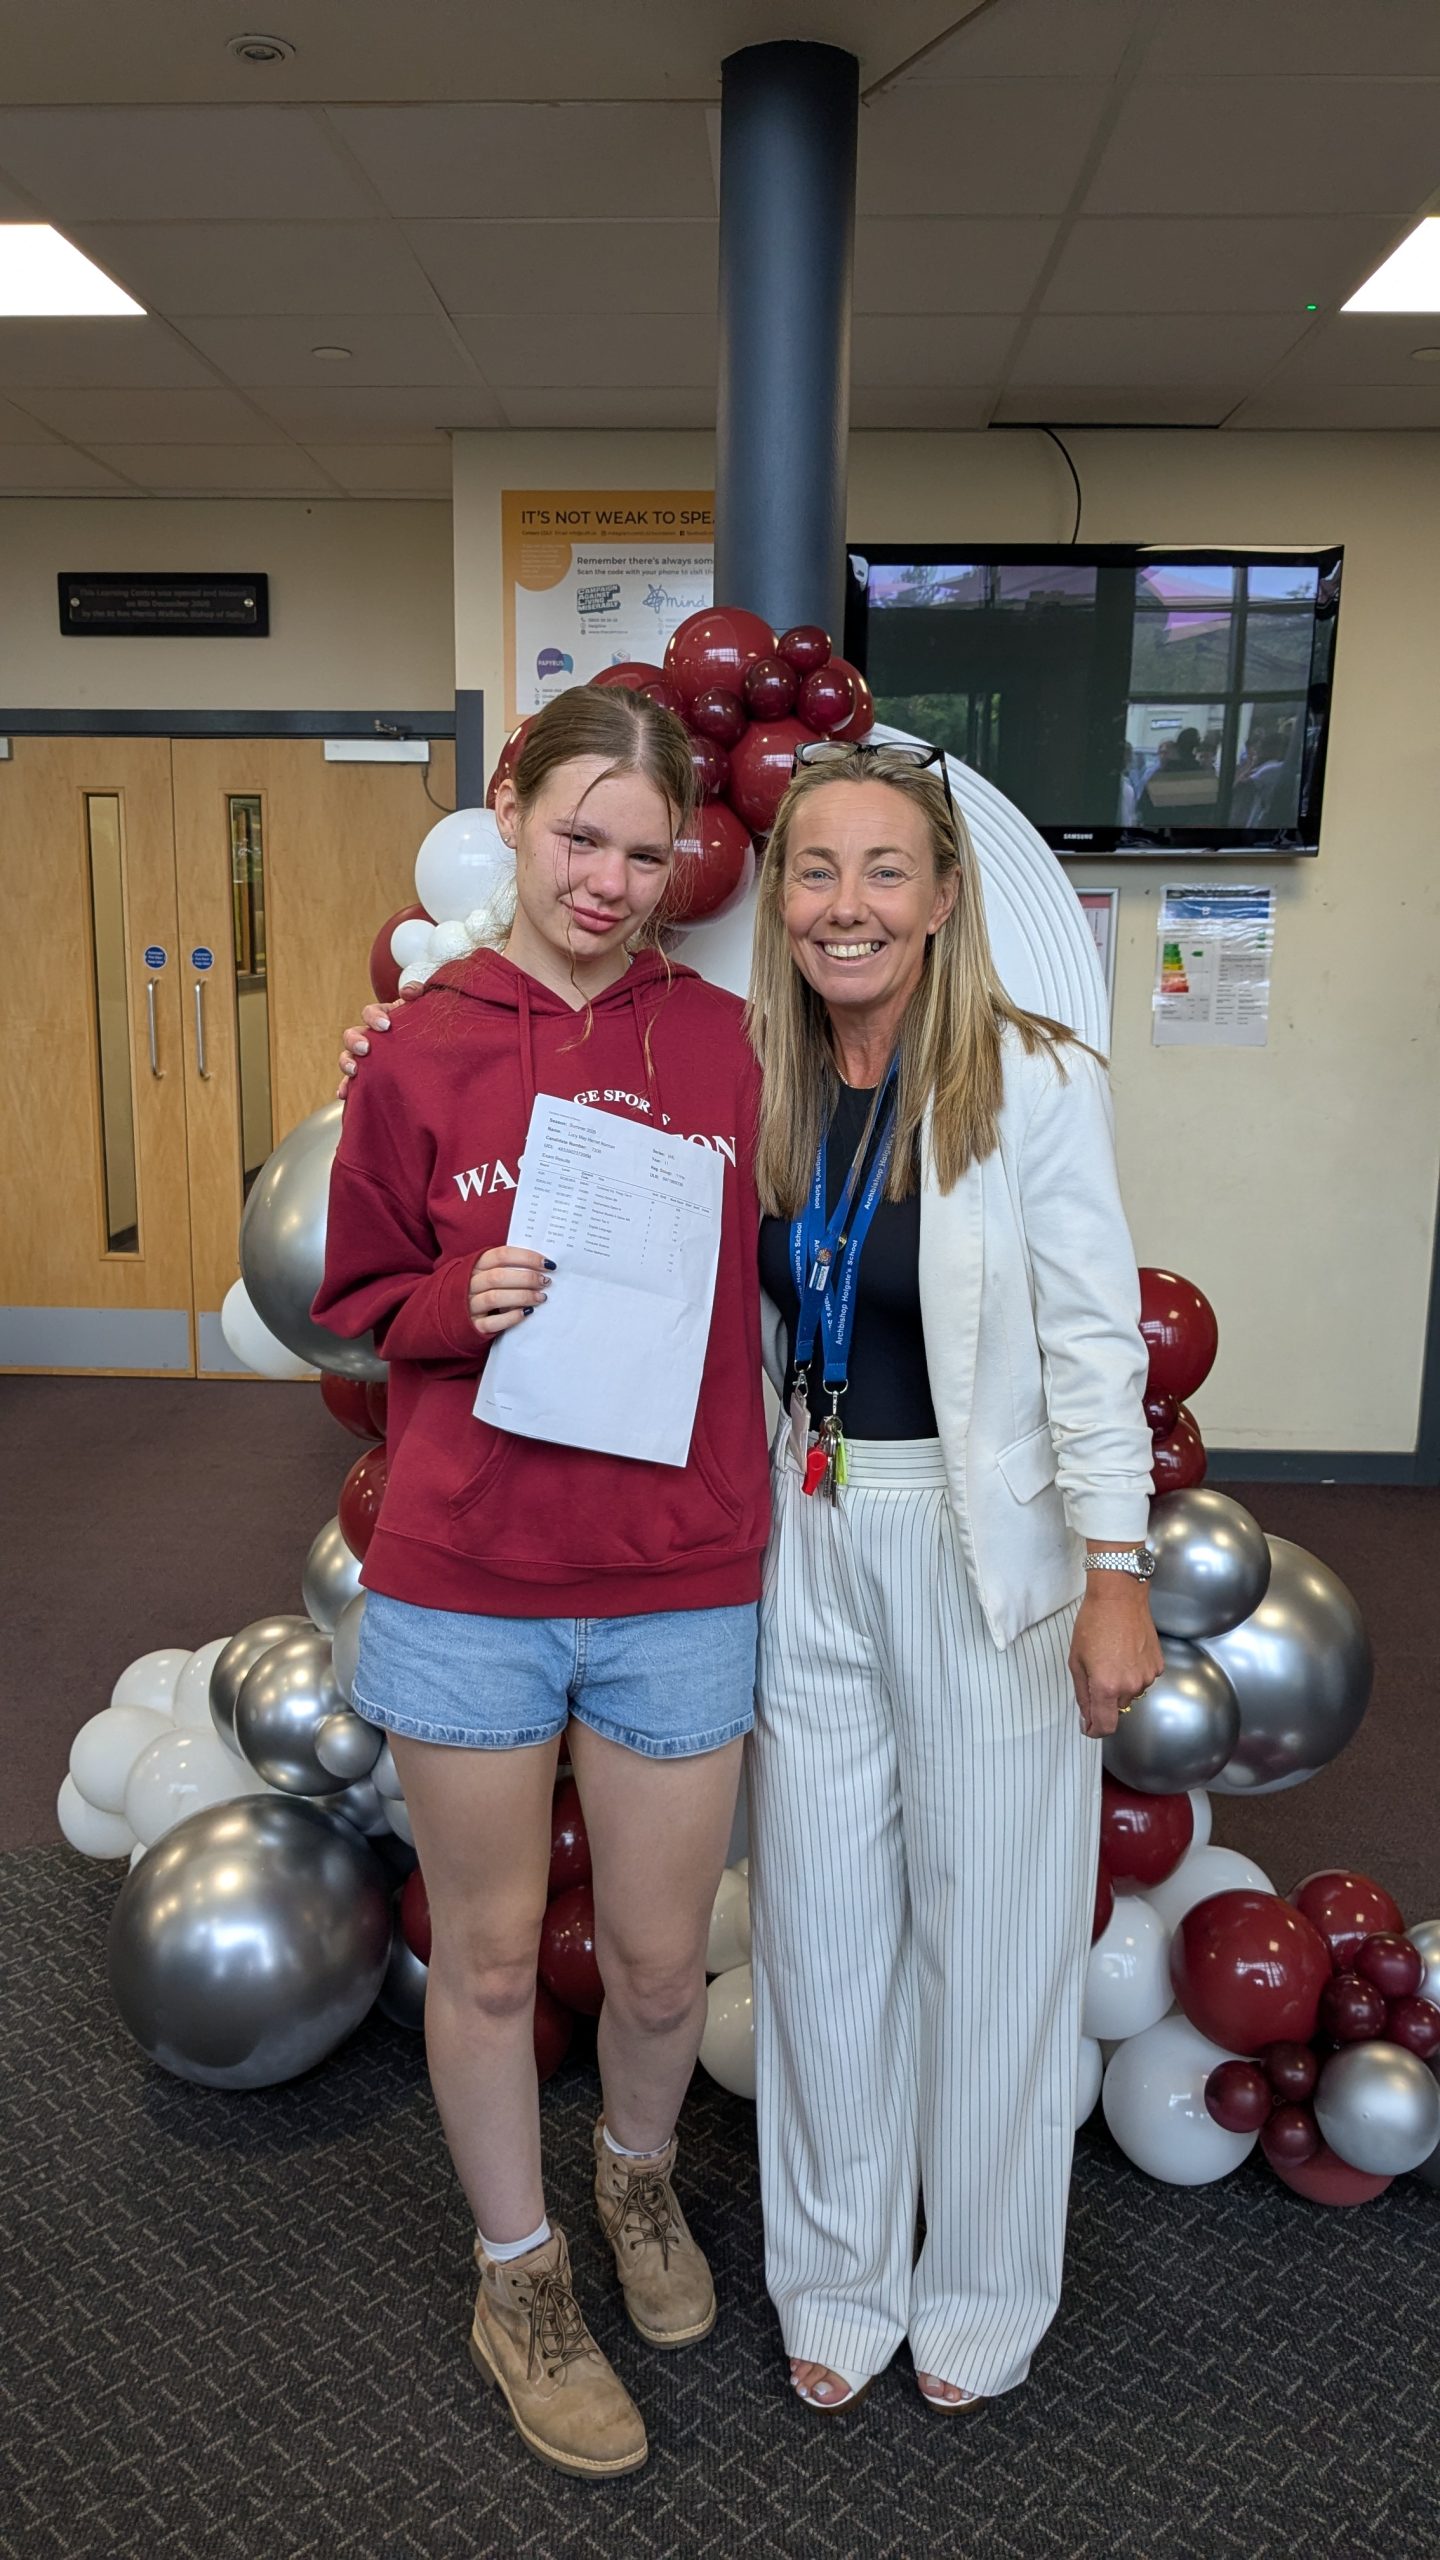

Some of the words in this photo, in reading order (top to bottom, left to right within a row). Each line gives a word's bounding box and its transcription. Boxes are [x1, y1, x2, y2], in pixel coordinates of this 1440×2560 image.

[522, 511, 550, 524] IT'S
[556, 511, 591, 524] NOT
[596, 511, 648, 524] WEAK
[652, 511, 676, 524] TO
[680, 511, 715, 524] SPE
[577, 556, 626, 565] Remember
[629, 556, 660, 565] there's
[662, 556, 692, 566] always
[578, 584, 618, 594] CAMPAIGN
[578, 591, 611, 600] AGAINST
[666, 594, 709, 608] mind
[604, 1090, 653, 1116] SPOR
[836, 1304, 848, 1345] Archbishop
[842, 1268, 852, 1302] Holgate's
[848, 1240, 858, 1266] School
